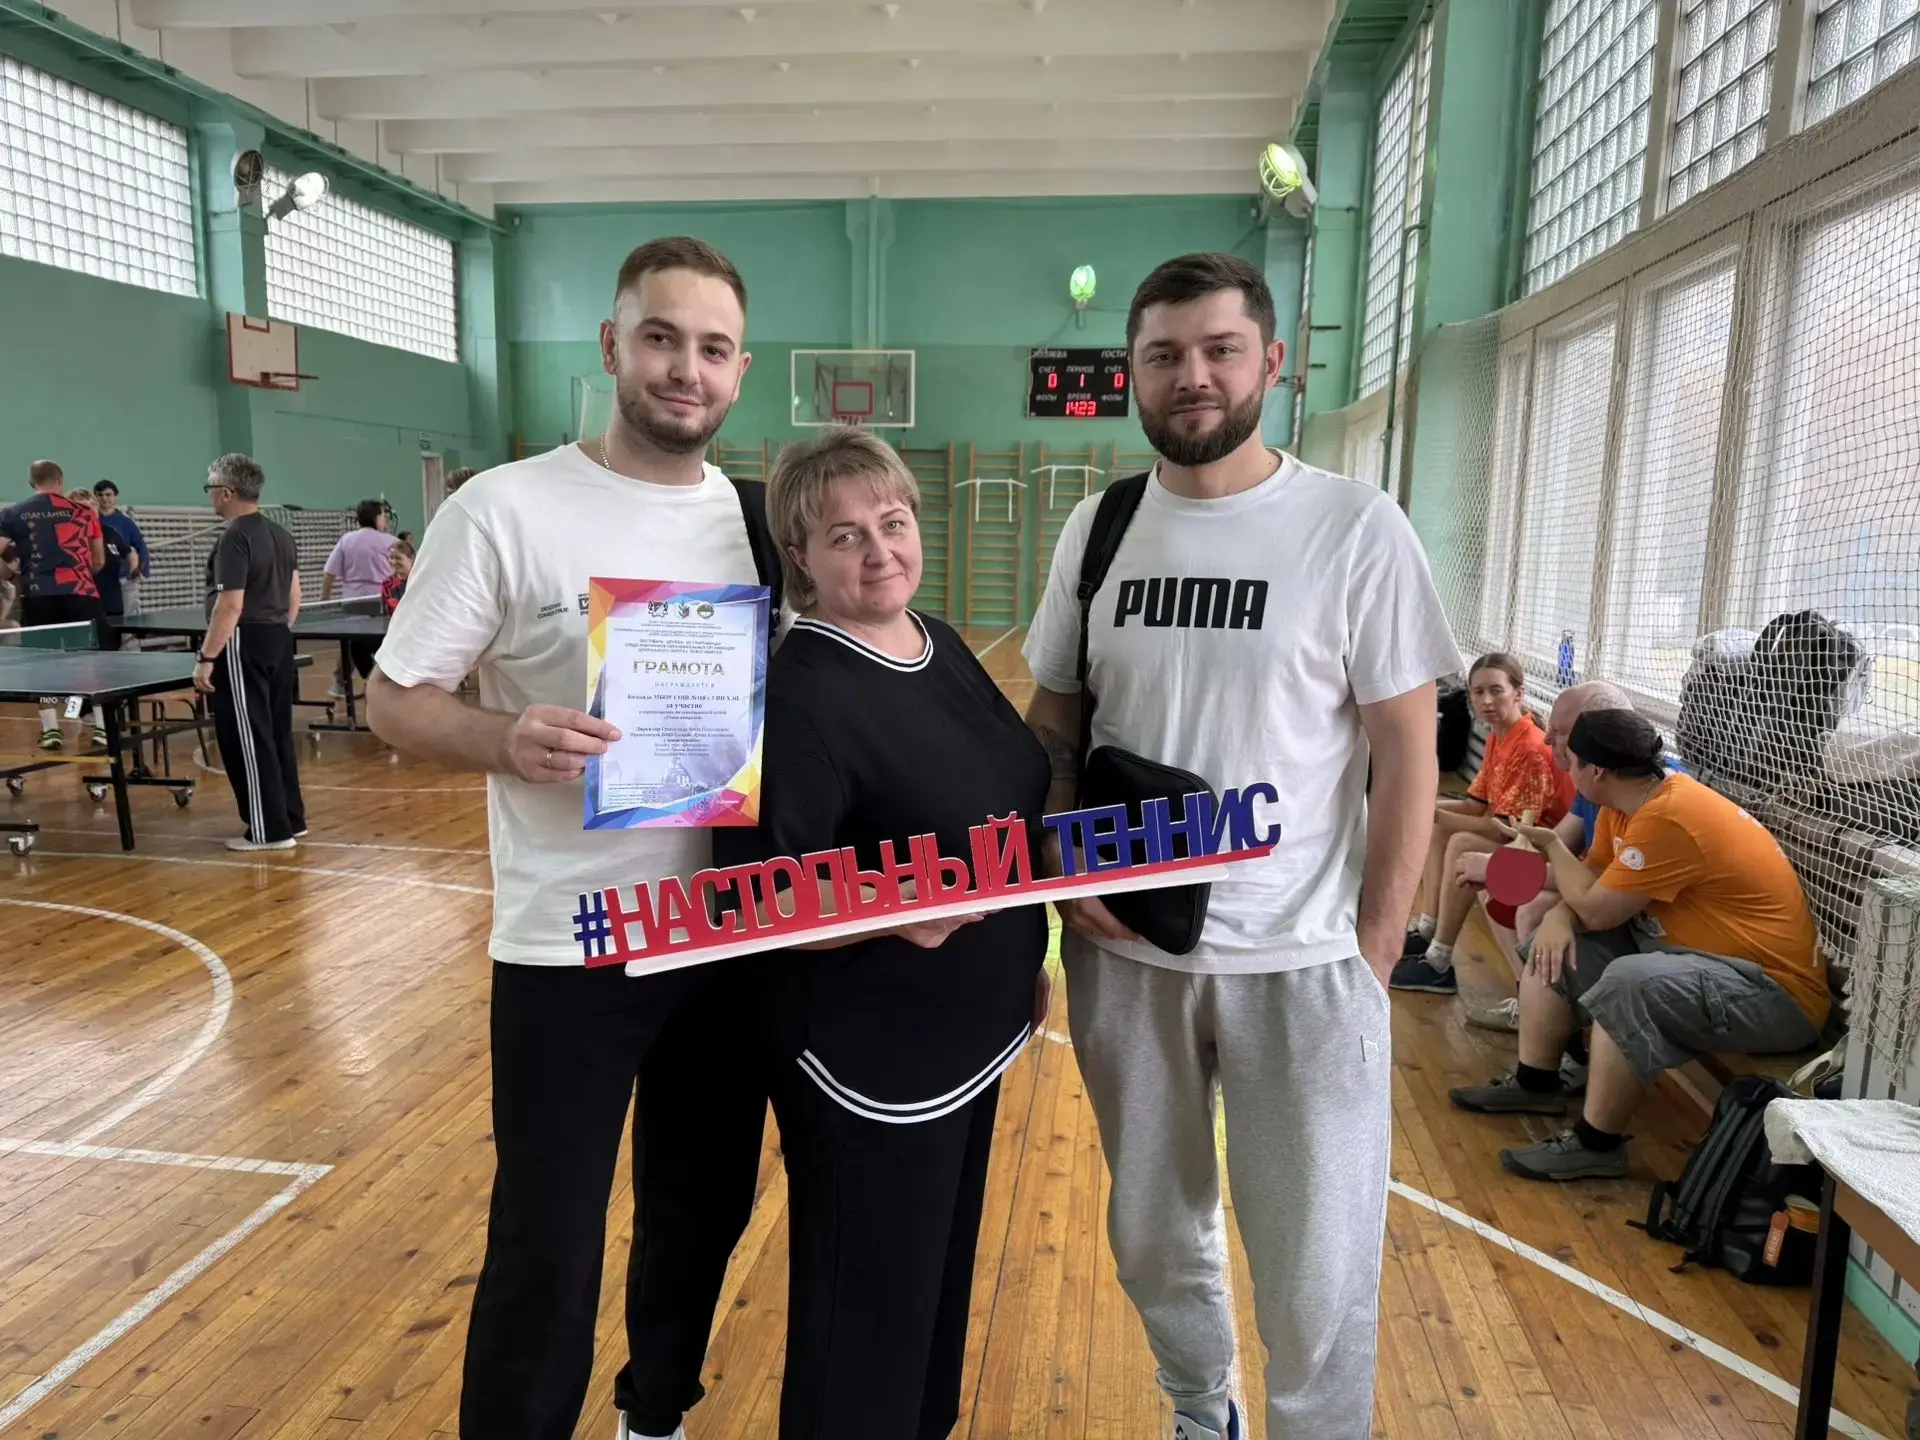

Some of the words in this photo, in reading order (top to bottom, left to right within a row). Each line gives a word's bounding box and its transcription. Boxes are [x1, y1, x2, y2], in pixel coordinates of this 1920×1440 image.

[1101, 350, 1127, 358] ГОСТИ
[1048, 373, 1057, 388] 0
[1080, 373, 1085, 388] 1
[1114, 373, 1124, 388] 0
[1113, 577, 1269, 630] PUMA
[633, 659, 725, 676] ГРАМОТА
[572, 811, 1033, 960] #НАСТОЛЬНЫЙ
[1042, 782, 1281, 877] ТЕННИС
